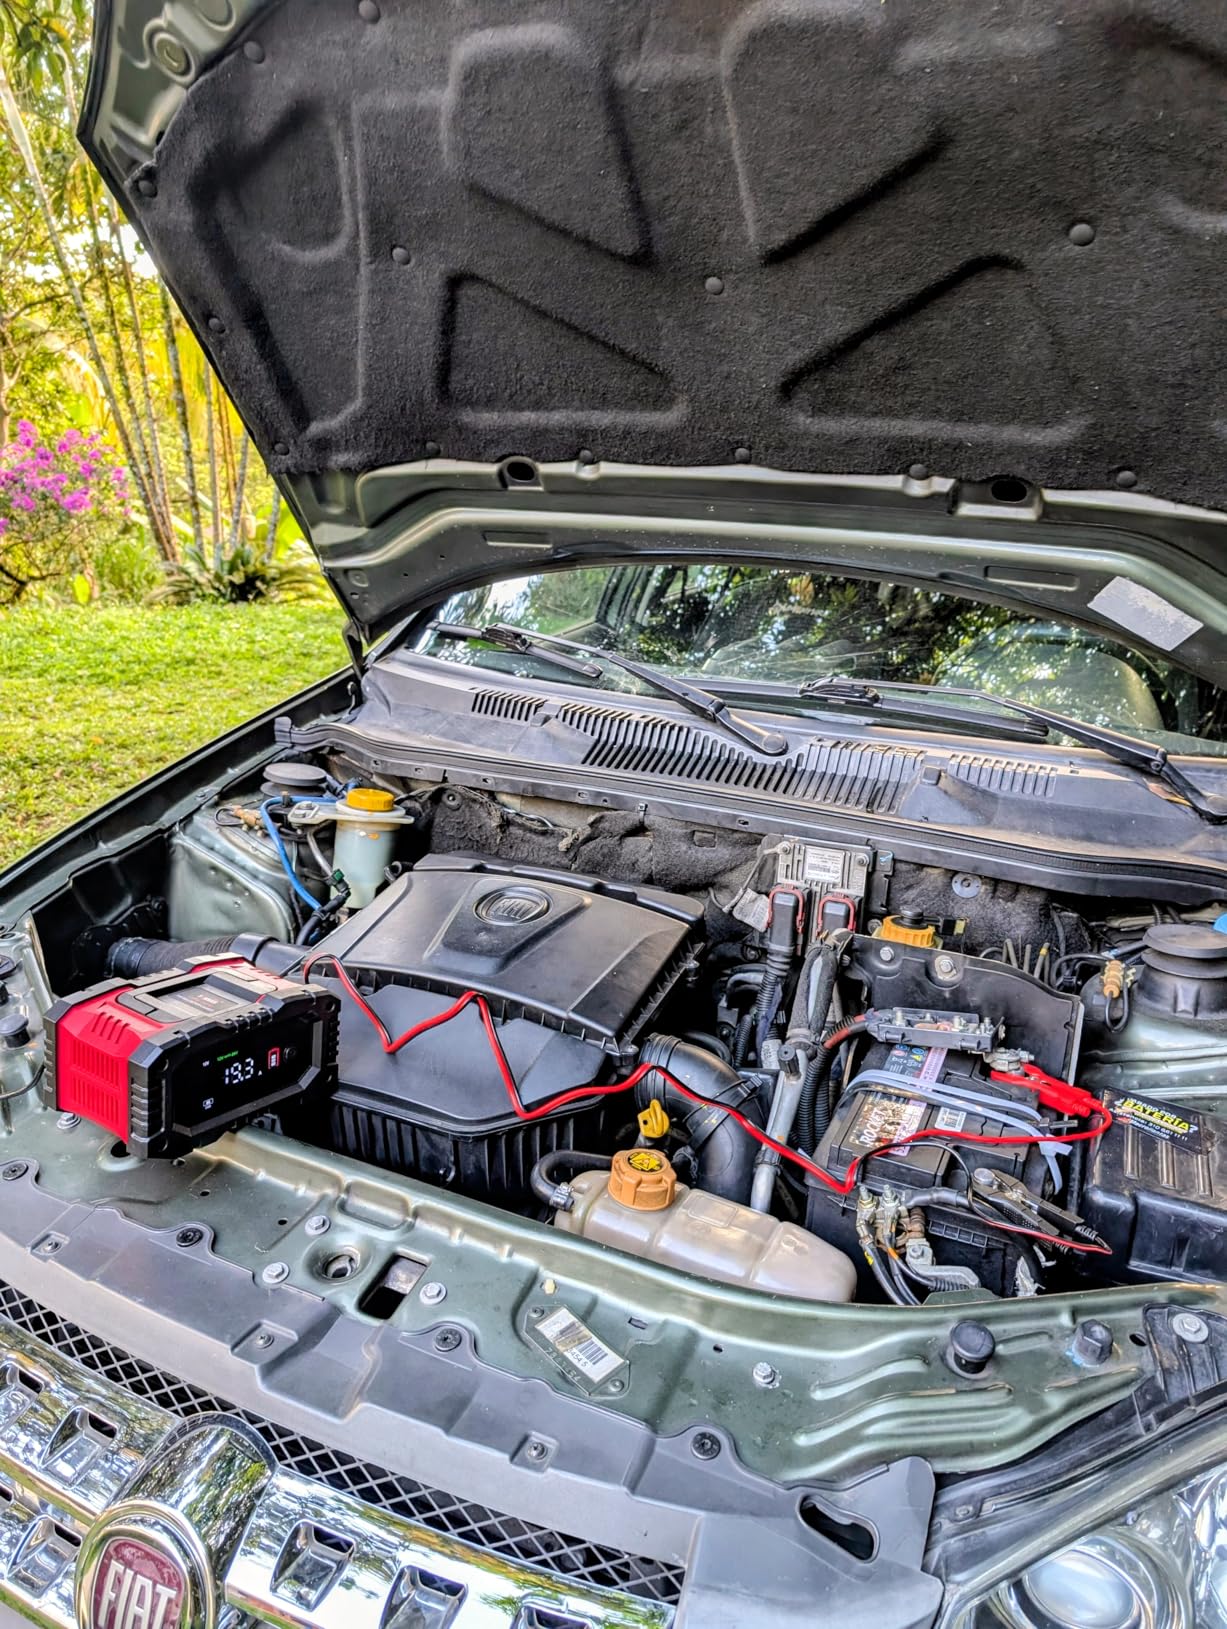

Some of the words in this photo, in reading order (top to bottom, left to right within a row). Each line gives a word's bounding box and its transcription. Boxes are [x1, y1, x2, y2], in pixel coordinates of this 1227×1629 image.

[489, 898, 538, 920] FIAT
[859, 1106, 887, 1147] ROCKET
[97, 1559, 178, 1629] FIAT
